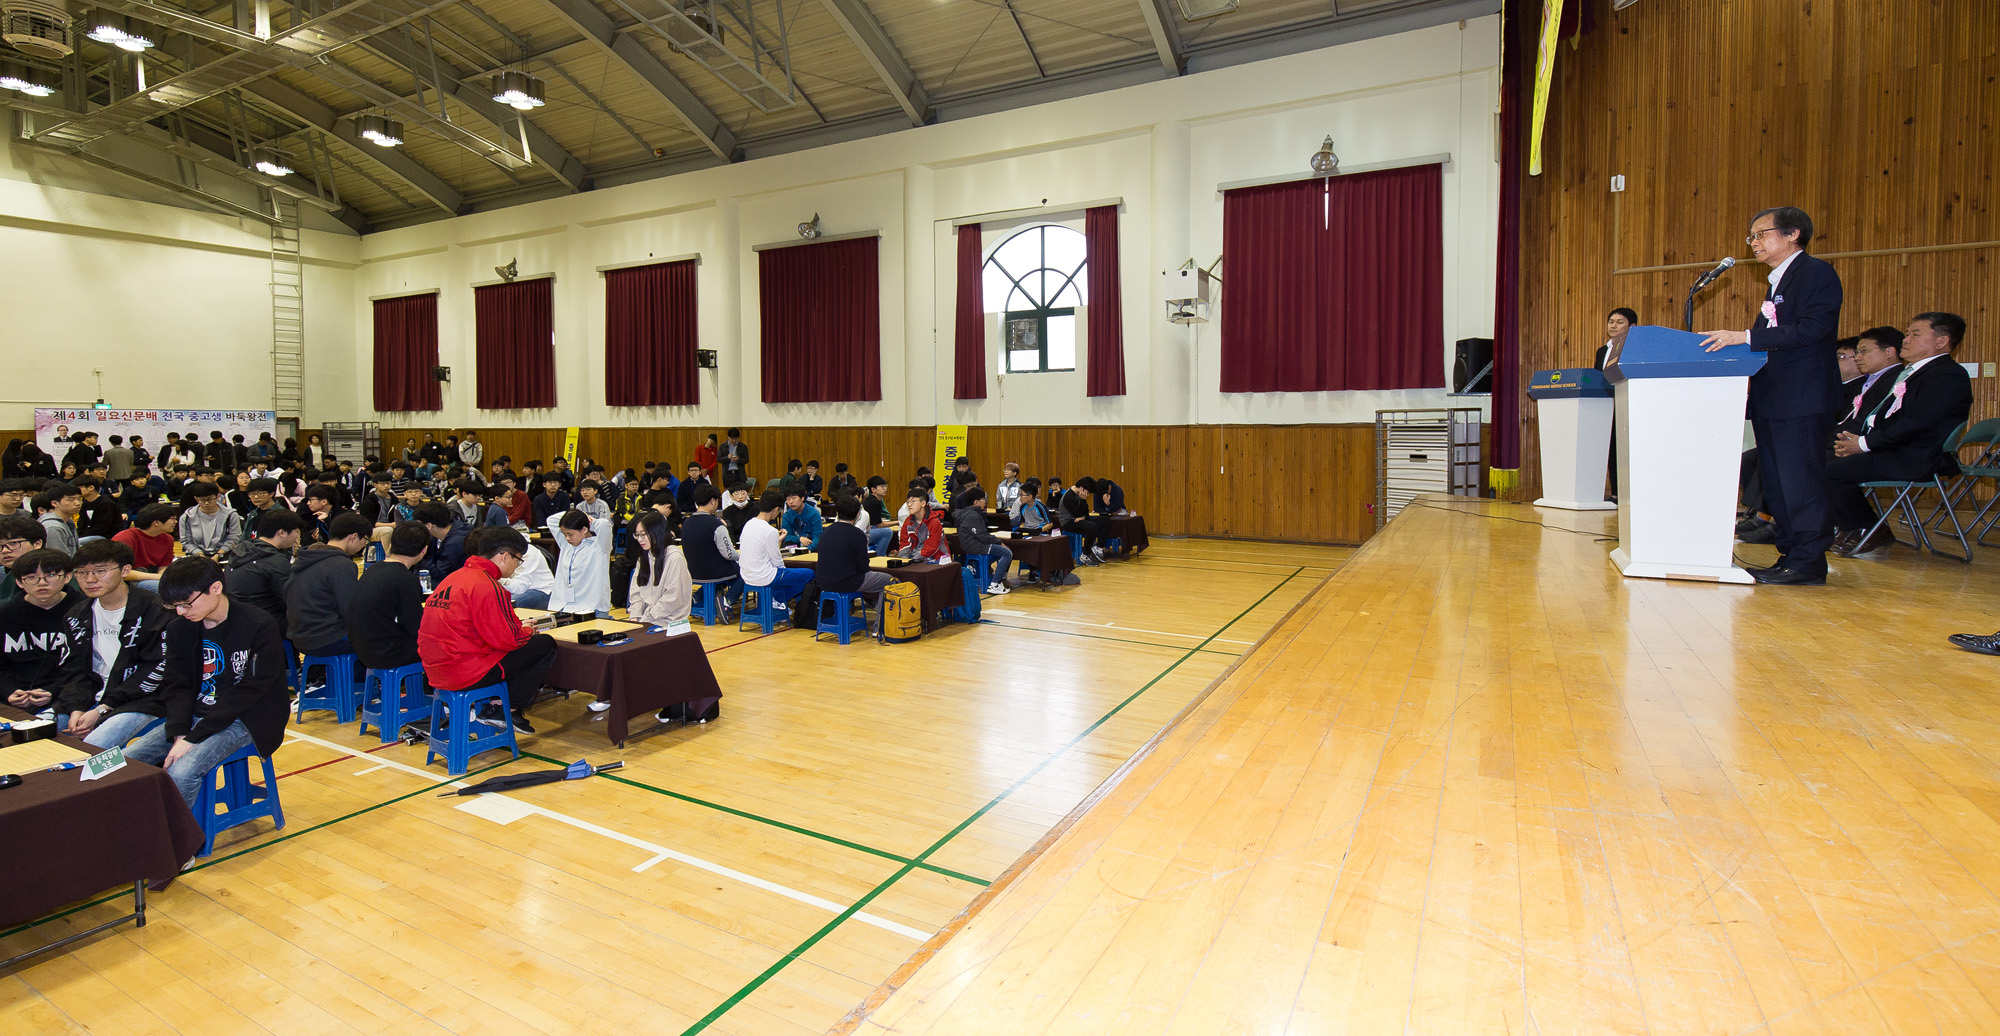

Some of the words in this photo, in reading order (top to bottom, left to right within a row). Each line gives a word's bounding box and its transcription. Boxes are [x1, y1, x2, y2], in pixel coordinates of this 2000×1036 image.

[53, 410, 90, 421] 제4회
[95, 411, 158, 422] 일요신문배
[162, 411, 185, 422] 전국
[188, 411, 222, 422] 중고생
[225, 411, 267, 422] 바둑왕전
[428, 599, 450, 610] adidas
